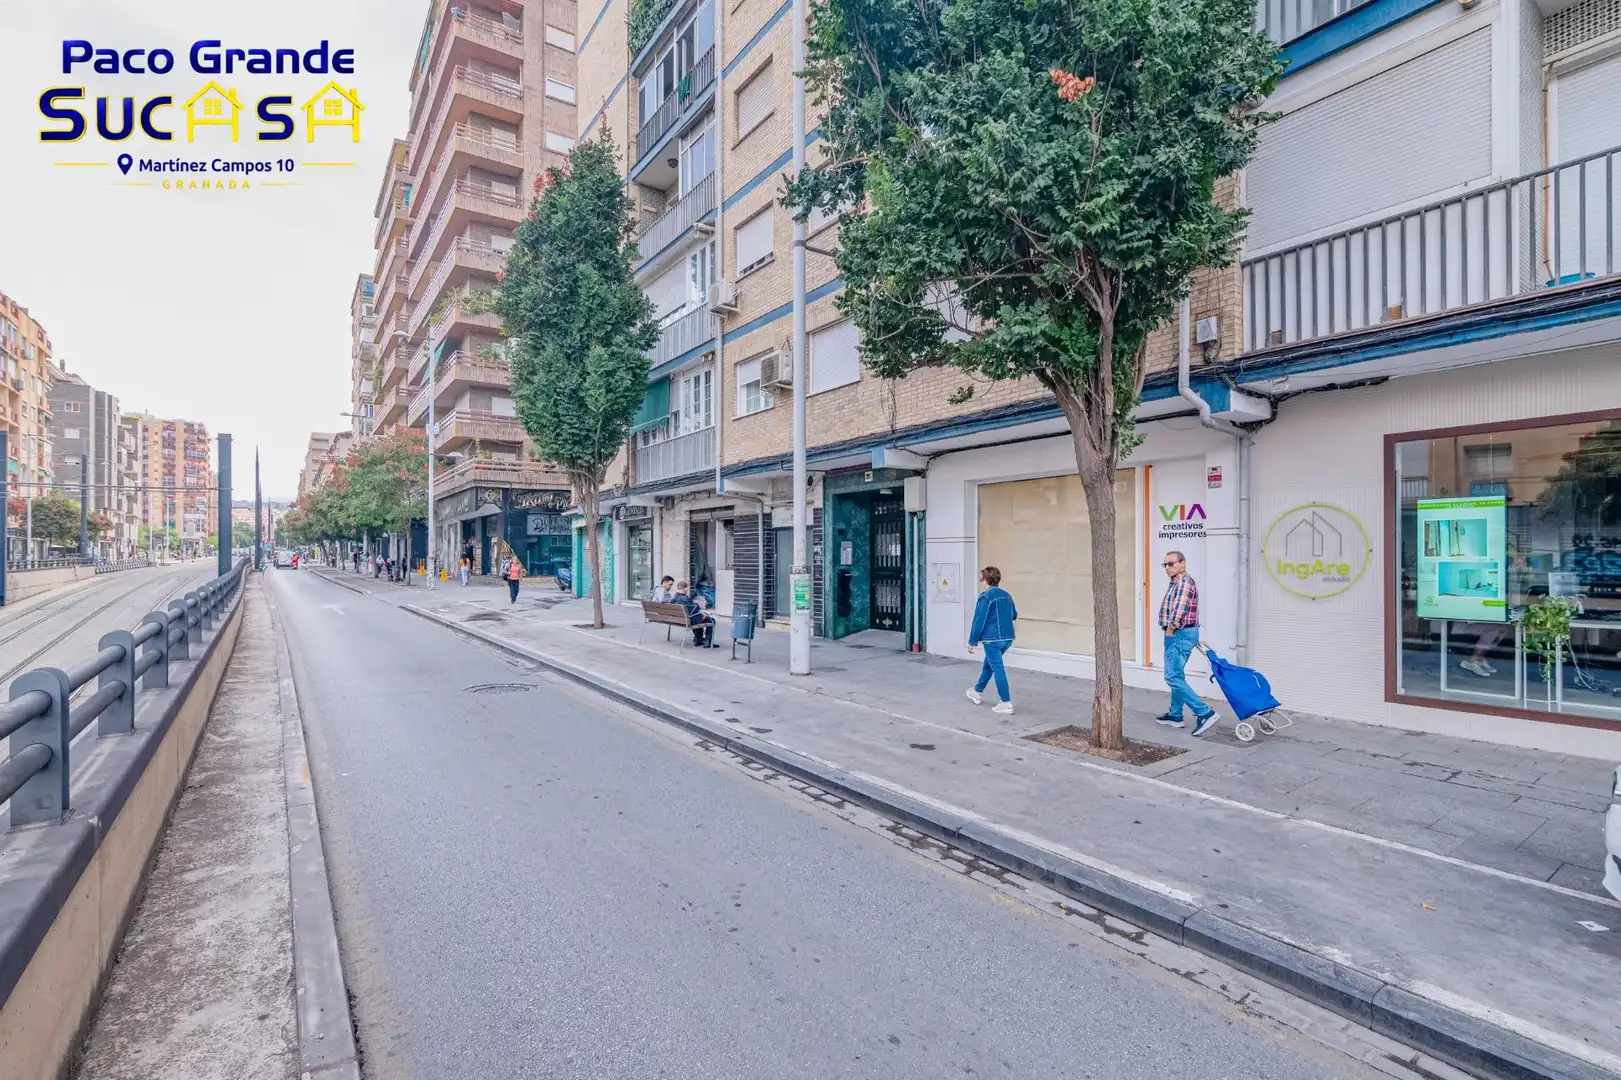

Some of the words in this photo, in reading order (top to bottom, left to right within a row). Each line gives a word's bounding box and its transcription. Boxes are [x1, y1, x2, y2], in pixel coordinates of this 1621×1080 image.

[1158, 503, 1207, 521] VIA
[1163, 521, 1204, 531] creativos
[1158, 530, 1208, 540] impresores
[1276, 557, 1352, 580] IngAre
